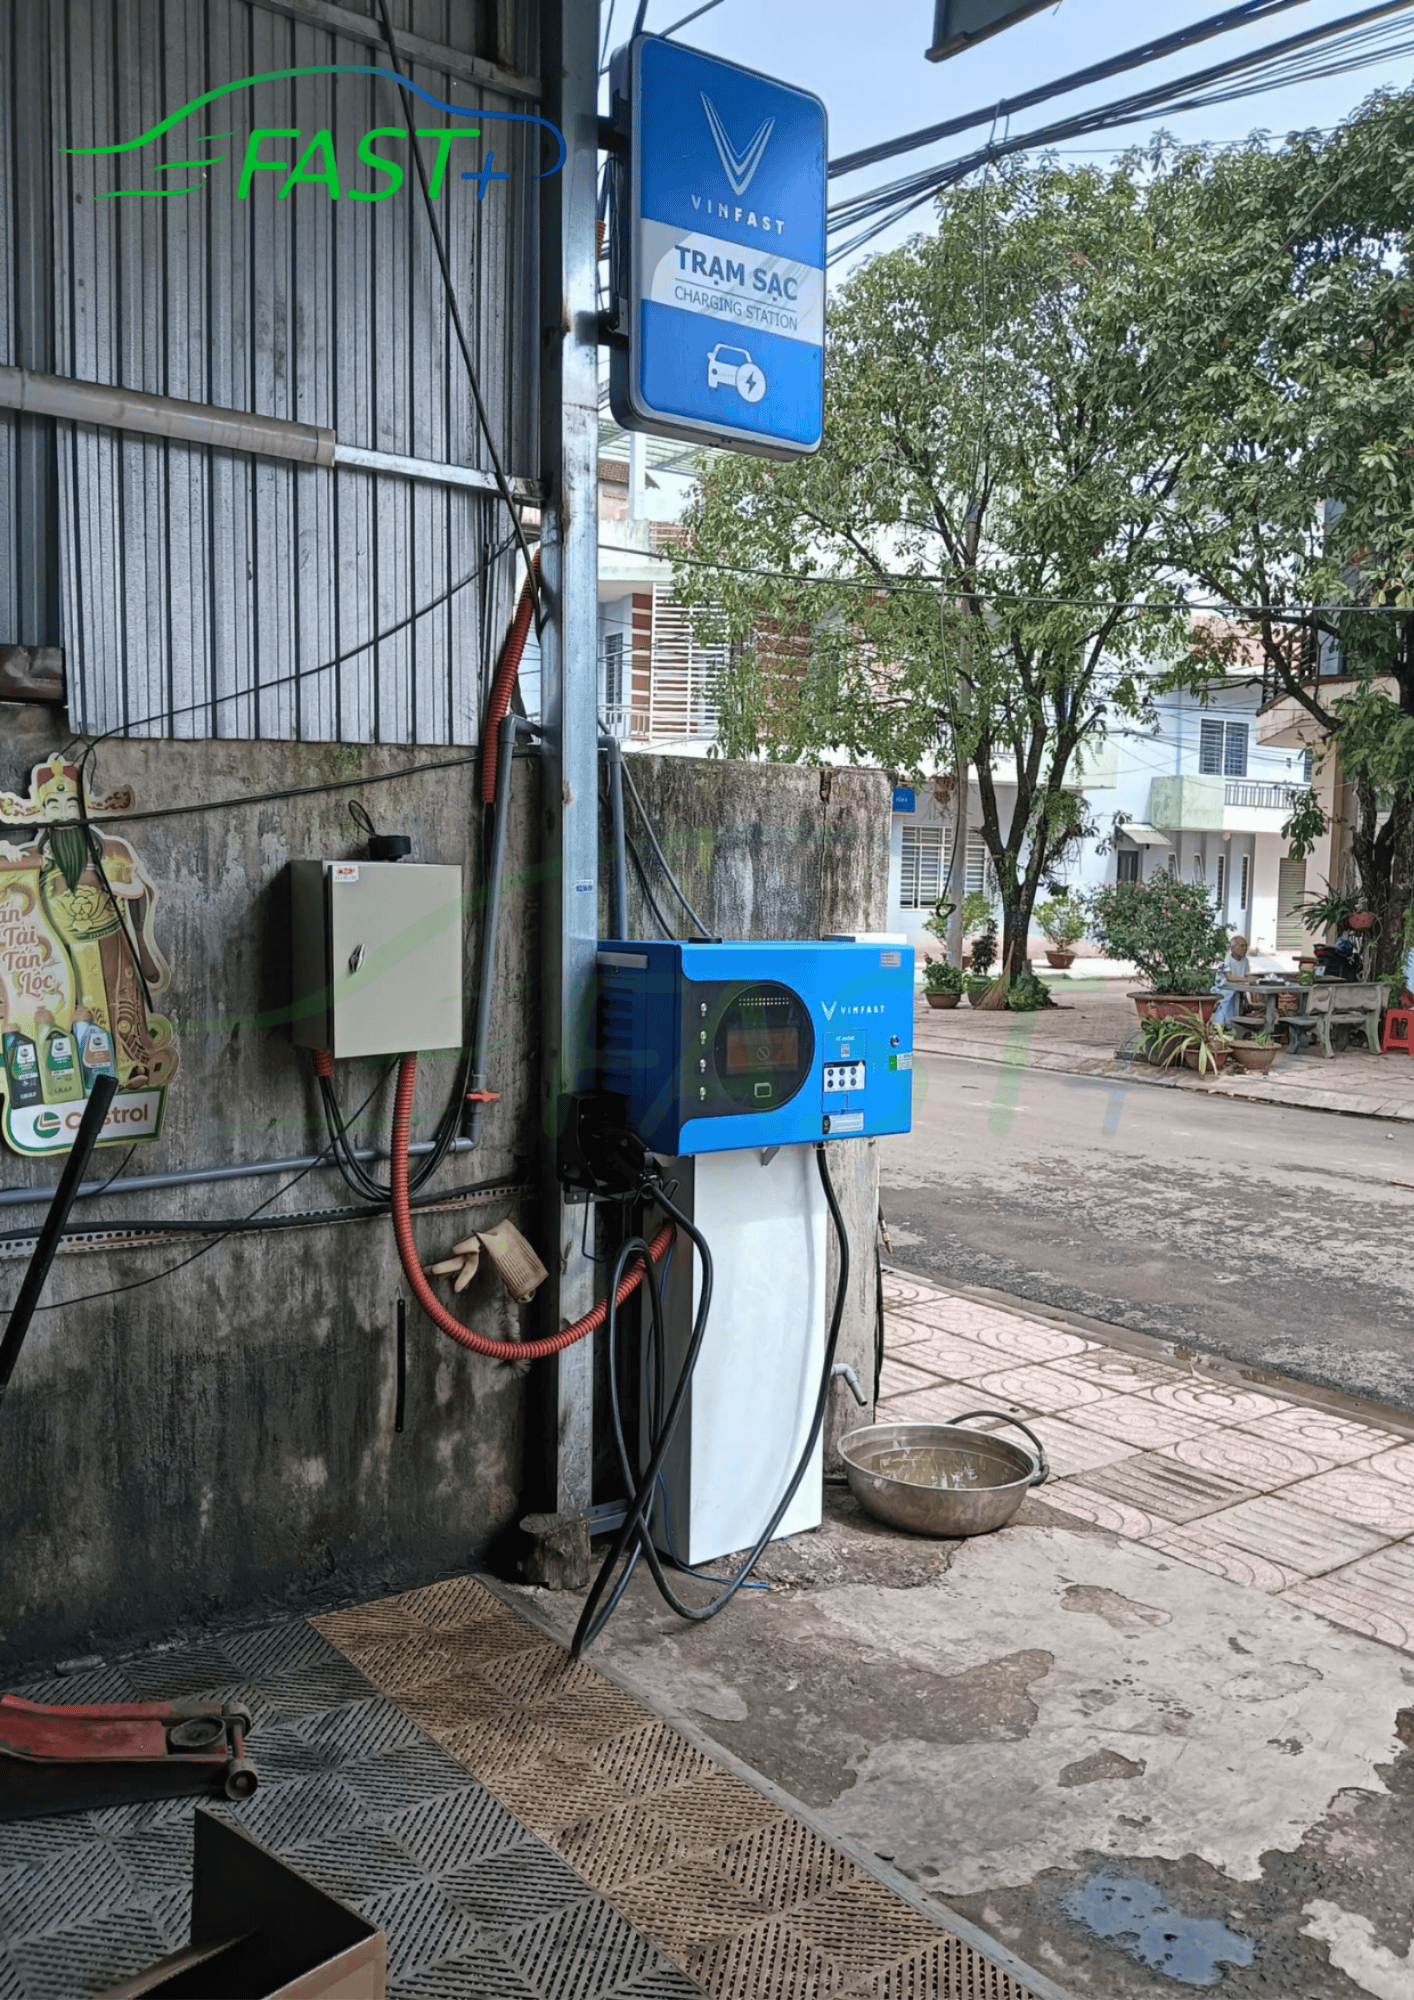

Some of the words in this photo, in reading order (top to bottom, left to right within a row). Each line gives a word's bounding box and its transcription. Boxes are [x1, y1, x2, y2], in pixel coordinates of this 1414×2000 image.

[691, 194, 785, 235] VINFAST
[675, 244, 745, 287] TRẠM
[753, 267, 798, 302] SẠC
[675, 285, 742, 317] CHARGING
[746, 304, 797, 331] STATION
[0, 901, 21, 924] ấn
[3, 925, 36, 947] Tài
[2, 946, 41, 971] Tấn
[841, 1004, 885, 1014] VINFAST
[65, 1103, 148, 1130] Cstrol
